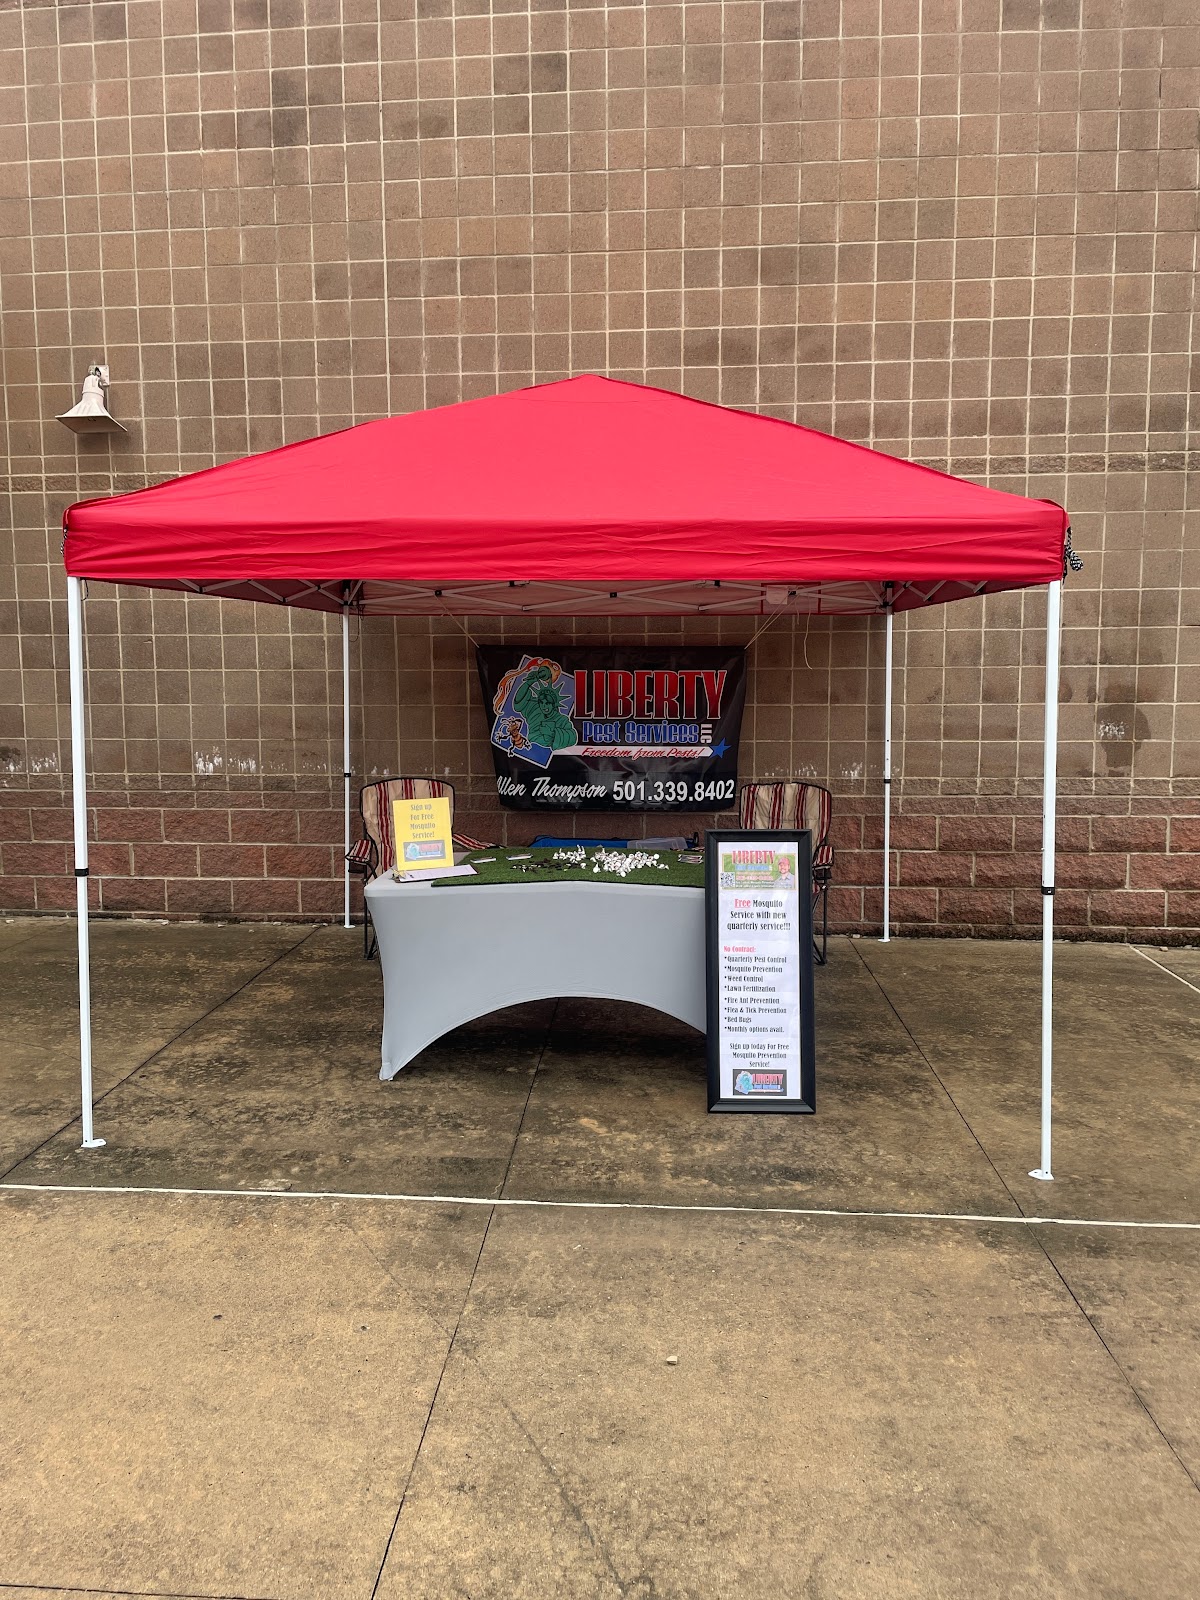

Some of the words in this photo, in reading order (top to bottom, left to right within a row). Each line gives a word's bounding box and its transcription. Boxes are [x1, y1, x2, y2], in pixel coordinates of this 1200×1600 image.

[574, 670, 727, 719] LIBERTY
[582, 721, 621, 743] Pest
[625, 720, 699, 744] Services
[700, 723, 713, 744] LLC
[581, 747, 632, 758] Freedom
[631, 748, 664, 761] from
[664, 747, 705, 759] Pests!
[531, 776, 608, 802] Thompson
[612, 779, 735, 801] 501.339.8402
[410, 822, 435, 830] Mosquito
[412, 831, 435, 839] Service!
[732, 851, 775, 864] LIBERTY
[734, 899, 751, 908] Free
[753, 900, 783, 908] Mosquito
[730, 911, 754, 919] Service
[756, 911, 771, 919] with
[727, 922, 758, 931] quarterly
[760, 922, 791, 931] service!!!
